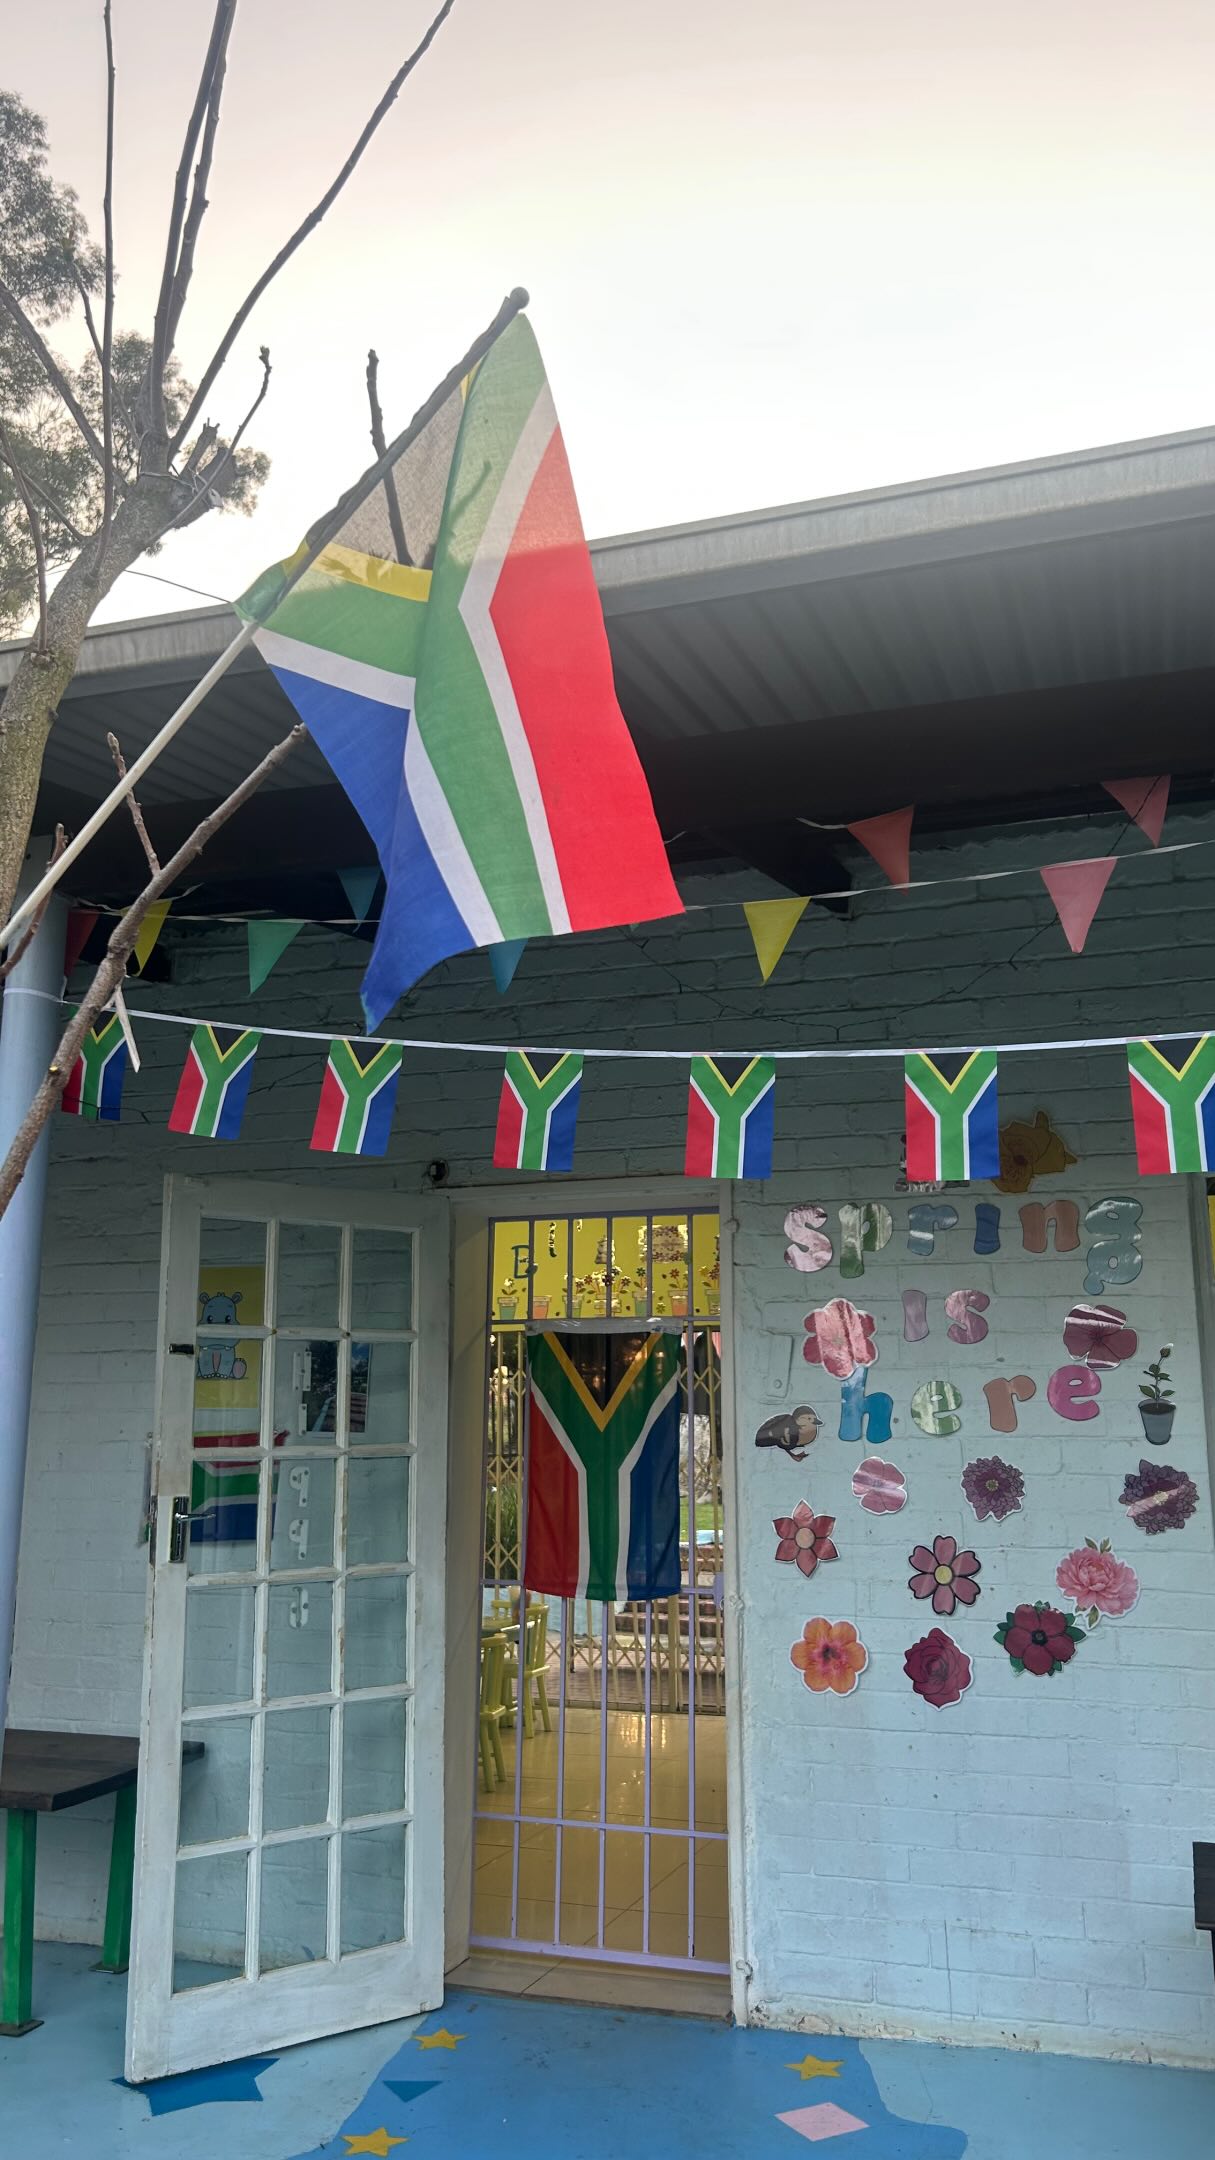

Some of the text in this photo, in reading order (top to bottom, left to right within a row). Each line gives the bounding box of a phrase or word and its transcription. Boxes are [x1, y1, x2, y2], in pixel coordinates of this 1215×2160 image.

[784, 1196, 1143, 1295] Spring
[902, 1289, 991, 1344] is
[838, 1365, 1102, 1443] here
